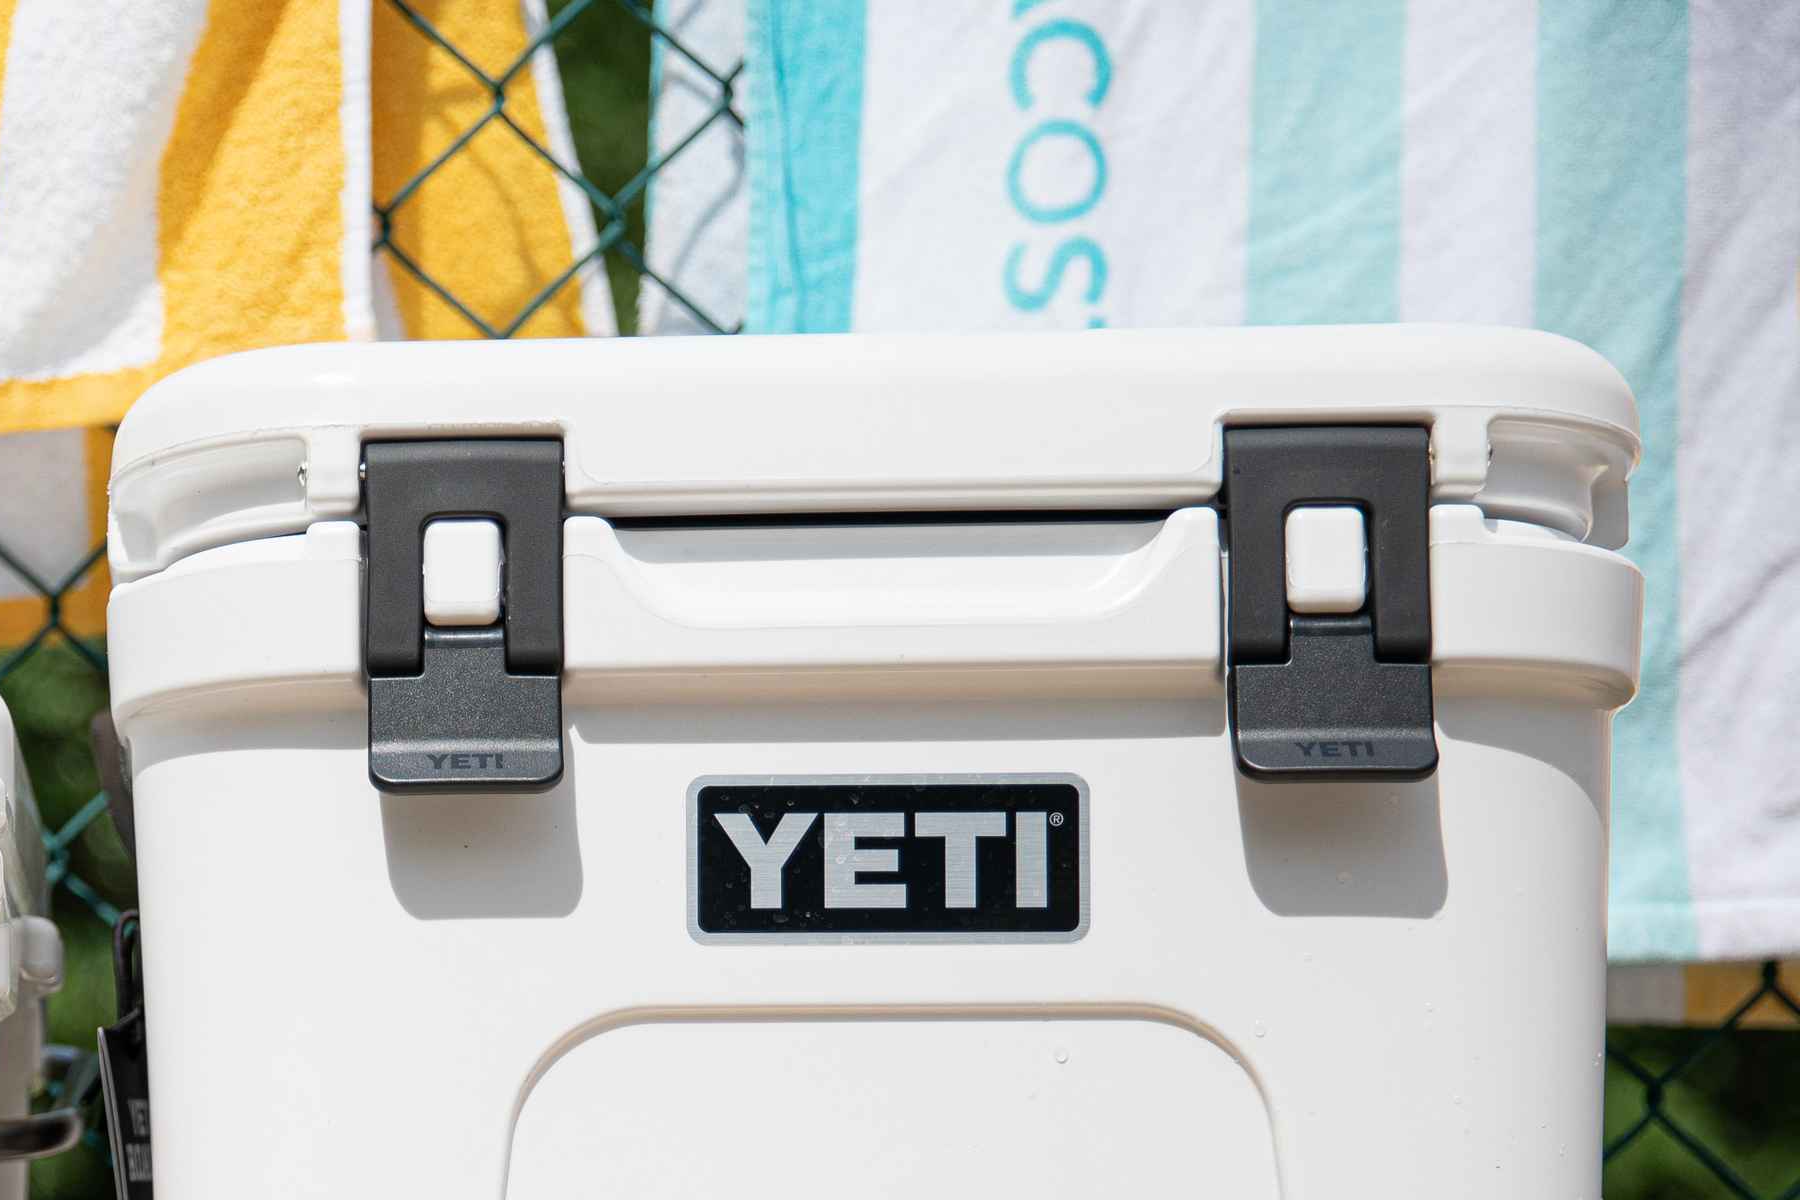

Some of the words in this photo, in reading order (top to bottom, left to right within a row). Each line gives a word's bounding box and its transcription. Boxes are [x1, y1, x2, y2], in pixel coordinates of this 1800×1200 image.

[1003, 0, 1112, 329] COS
[1293, 740, 1376, 758] YETI
[427, 753, 505, 770] YETI
